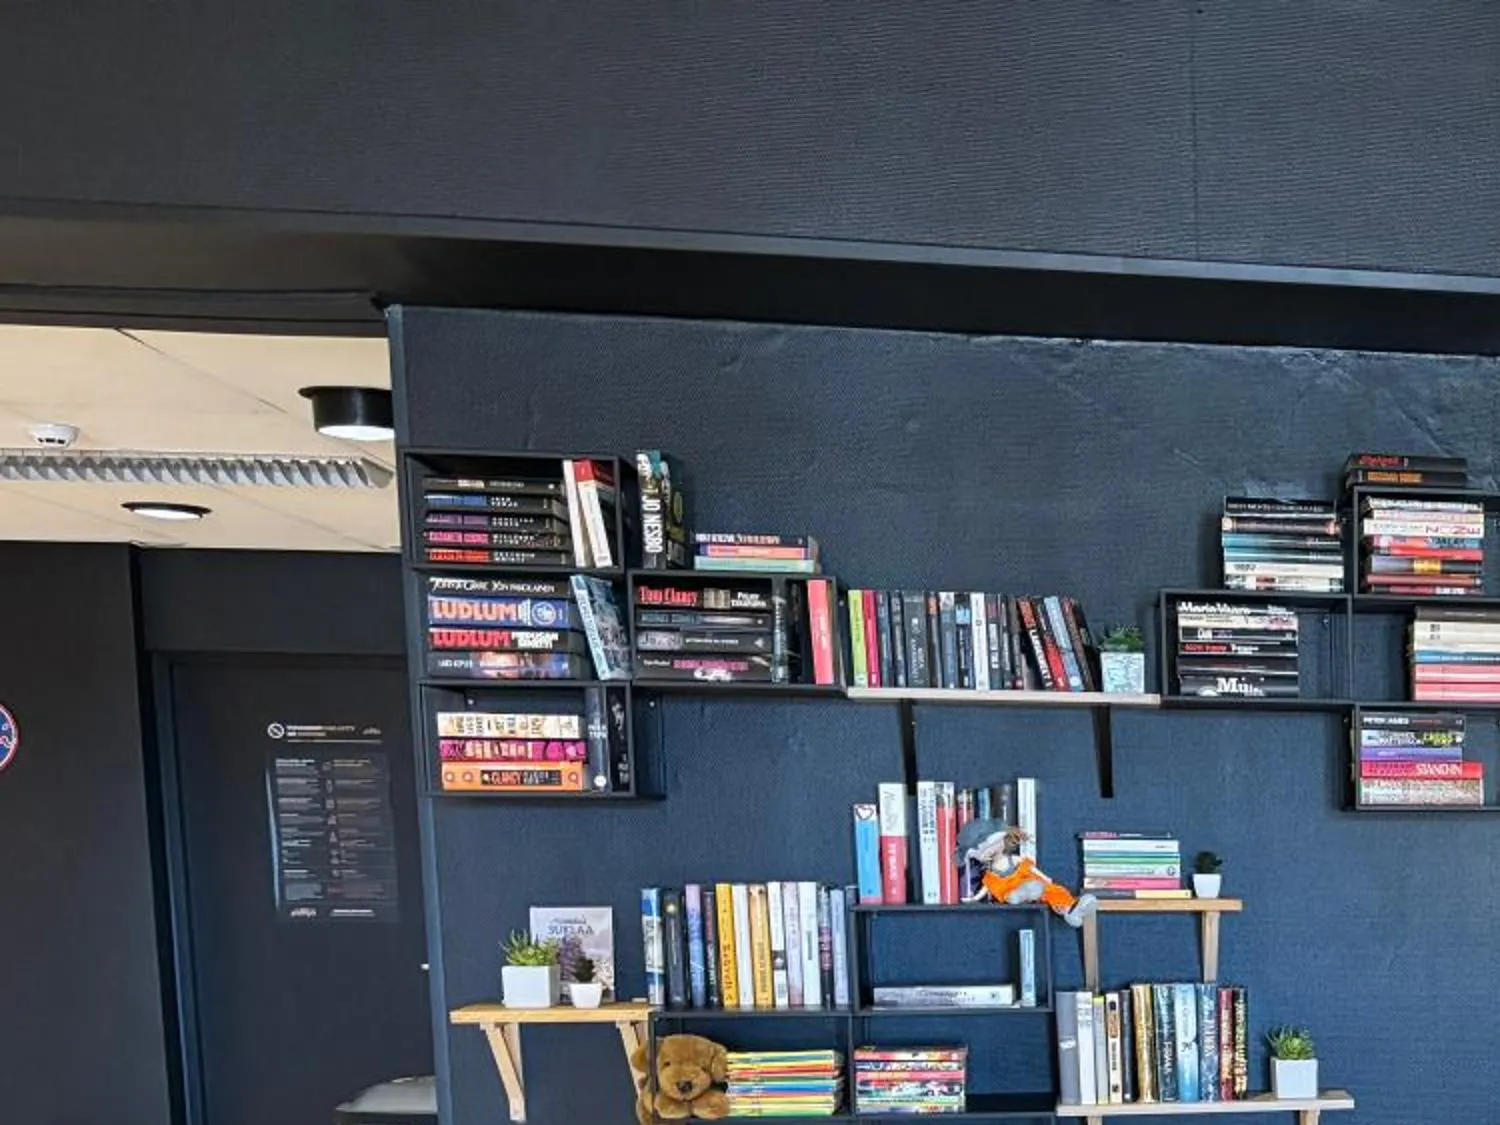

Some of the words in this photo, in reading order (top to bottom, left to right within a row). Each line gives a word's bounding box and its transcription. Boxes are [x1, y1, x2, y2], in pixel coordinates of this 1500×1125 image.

[664, 587, 699, 607] Clancy
[432, 600, 516, 621] LUDLUM
[432, 629, 511, 648] LUDLUM
